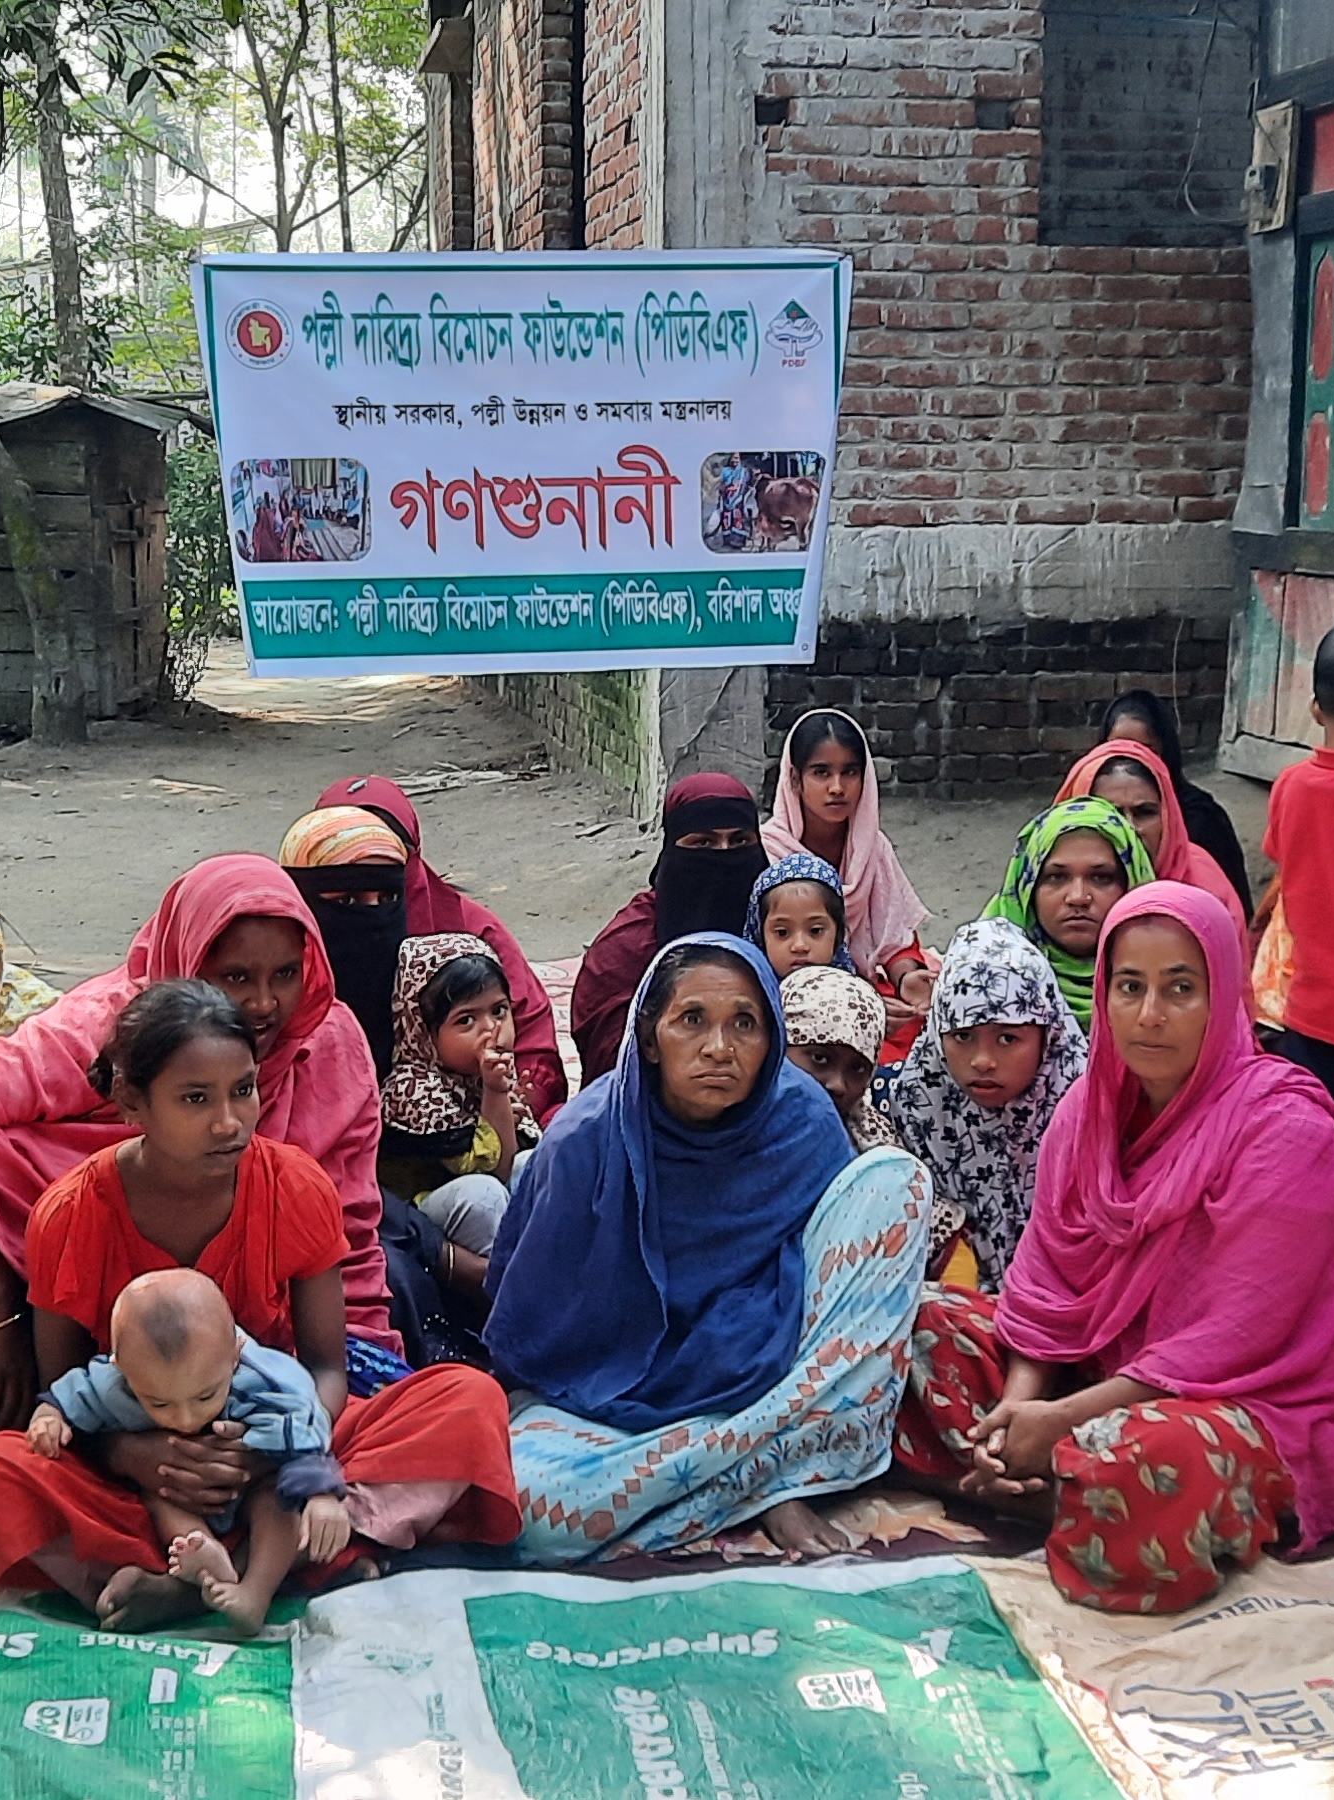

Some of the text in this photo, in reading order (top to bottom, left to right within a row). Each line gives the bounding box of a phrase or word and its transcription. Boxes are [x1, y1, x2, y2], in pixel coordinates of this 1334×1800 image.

[301, 289, 344, 371] পল্লী
[350, 292, 422, 374] দারিদ্র্য
[428, 292, 514, 366] বিমোচন
[519, 292, 625, 365] ফাউন্ডেশন
[634, 290, 759, 378] (পিডিবিএফ)
[332, 396, 387, 430] স্থানীয়
[393, 403, 464, 430] সরকার,
[470, 395, 506, 426] পল্লী
[512, 397, 566, 427] উন্নয়ন
[573, 403, 589, 422] ও
[594, 399, 653, 424] সমবায়
[389, 444, 683, 556] গণশুনানী
[250, 576, 803, 638] আয়োজনে: পল্লী দারিদ্র্য বিমোচন ফাউন্ডেশন (পিডিবিএফ), বরিশাল অঞ্চ
[78, 1632, 215, 1667] LAFARGE
[525, 1628, 780, 1669] Supercrete
